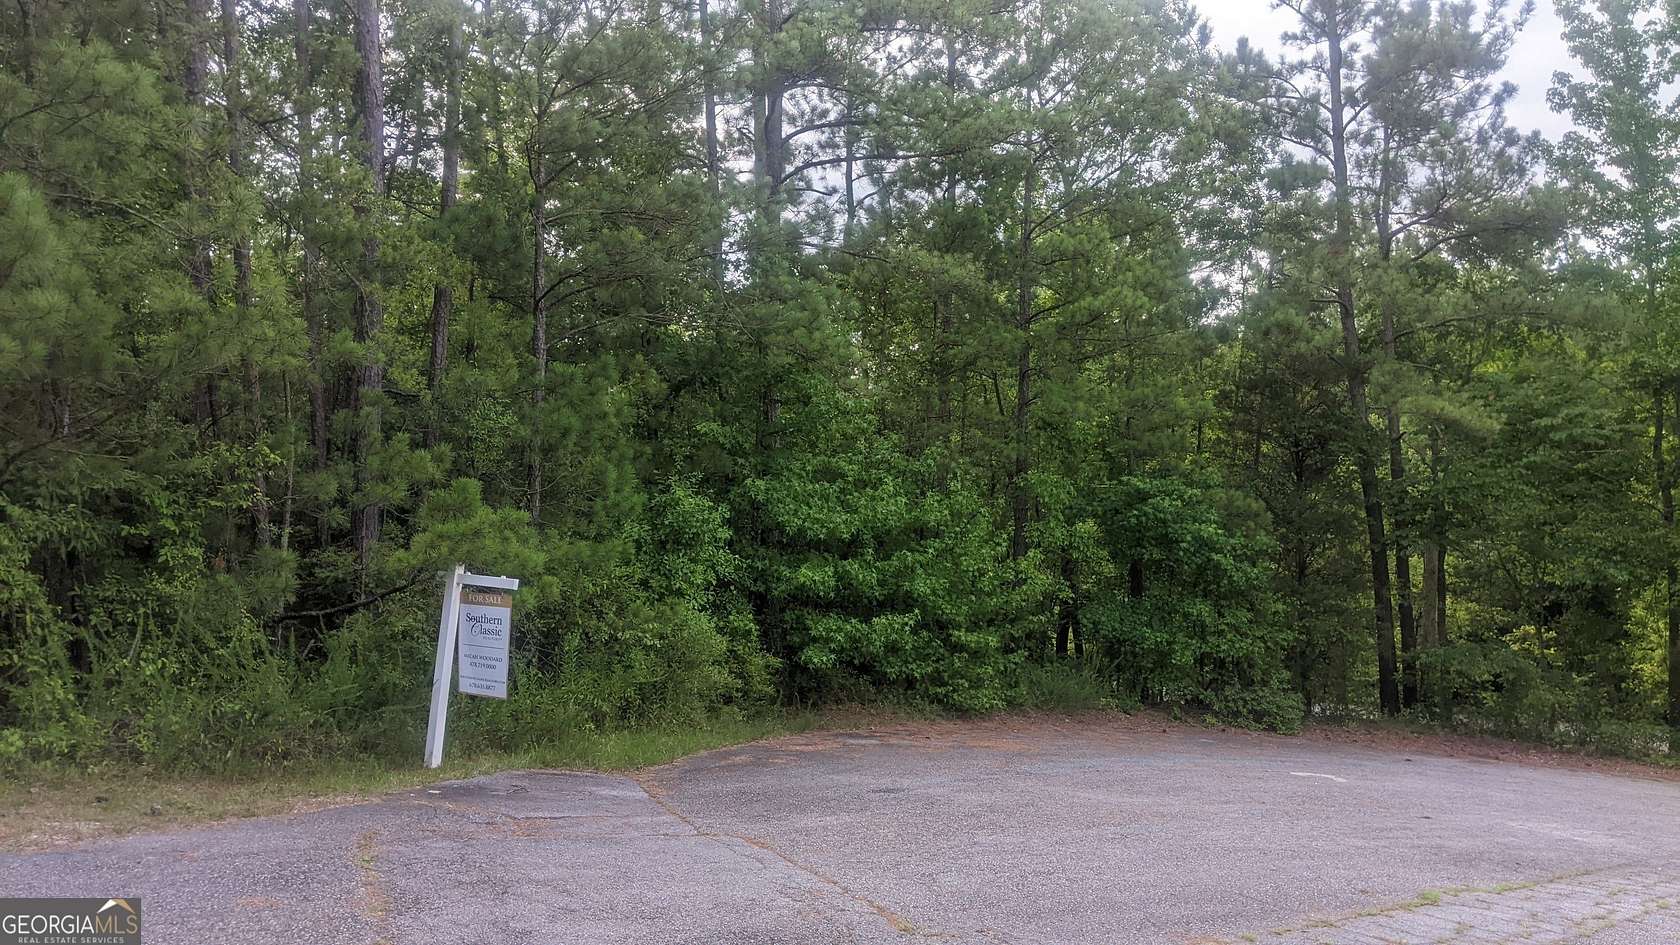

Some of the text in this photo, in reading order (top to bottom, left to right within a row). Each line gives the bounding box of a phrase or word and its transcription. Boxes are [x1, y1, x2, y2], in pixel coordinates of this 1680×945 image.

[468, 594, 504, 604] FOR SALE
[466, 612, 502, 625] Southern
[471, 622, 502, 637] Classic
